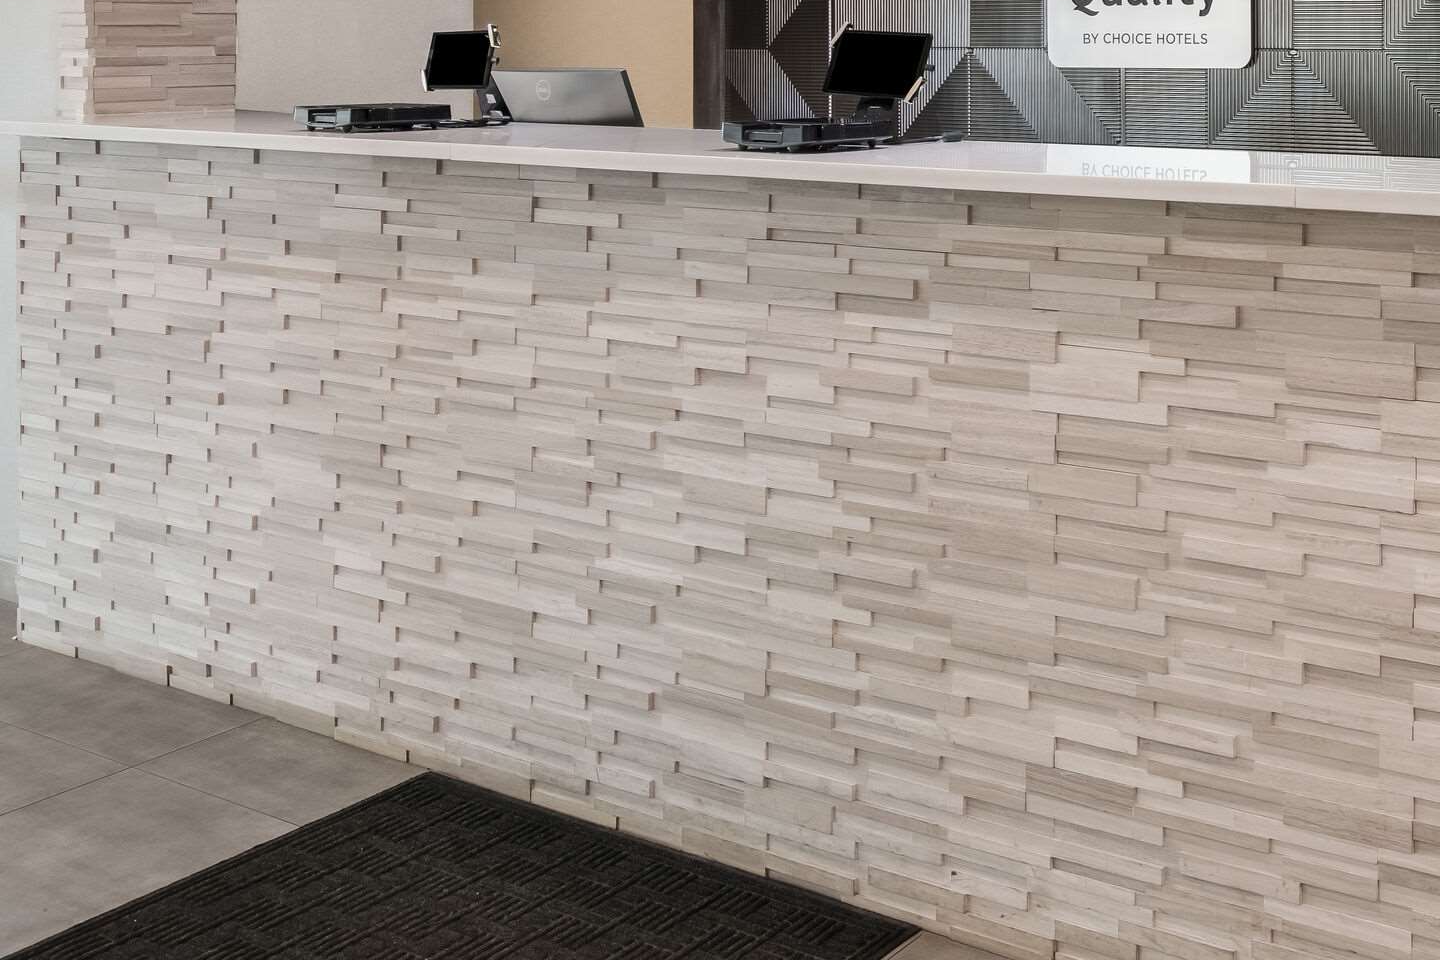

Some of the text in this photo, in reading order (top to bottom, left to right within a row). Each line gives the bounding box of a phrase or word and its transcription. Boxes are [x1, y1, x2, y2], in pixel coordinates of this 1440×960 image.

[1082, 32, 1208, 45] BY CHOICE HOTELS
